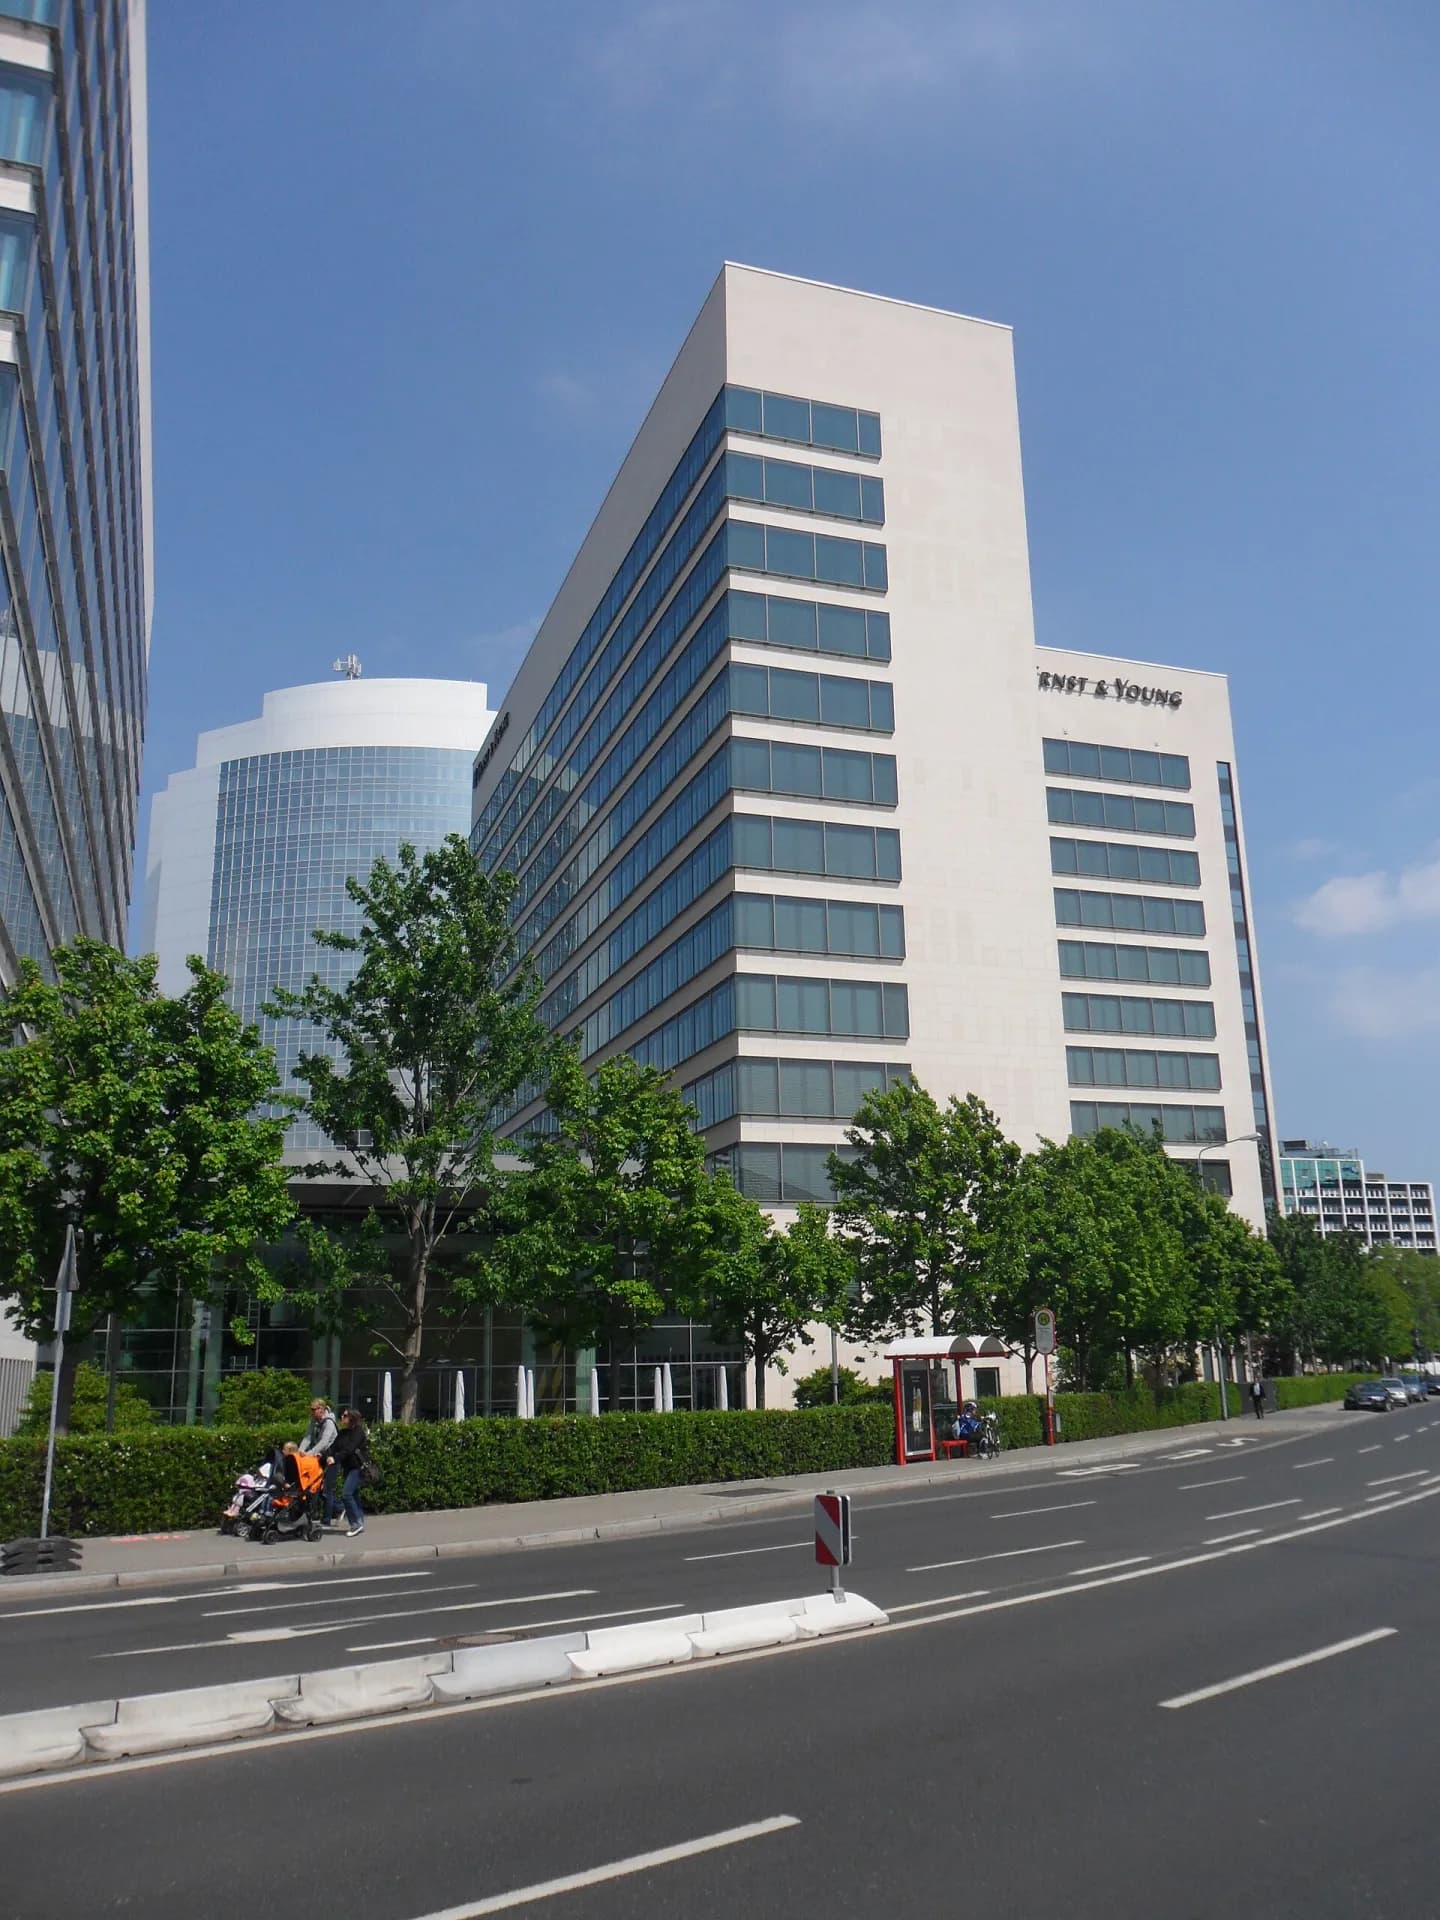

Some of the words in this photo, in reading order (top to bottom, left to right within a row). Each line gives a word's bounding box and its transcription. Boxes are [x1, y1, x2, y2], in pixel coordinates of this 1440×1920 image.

[1037, 668, 1088, 695] RNST
[1094, 680, 1109, 698] &
[1115, 678, 1182, 708] YOUNG
[1056, 1437, 1259, 1476] BUS
